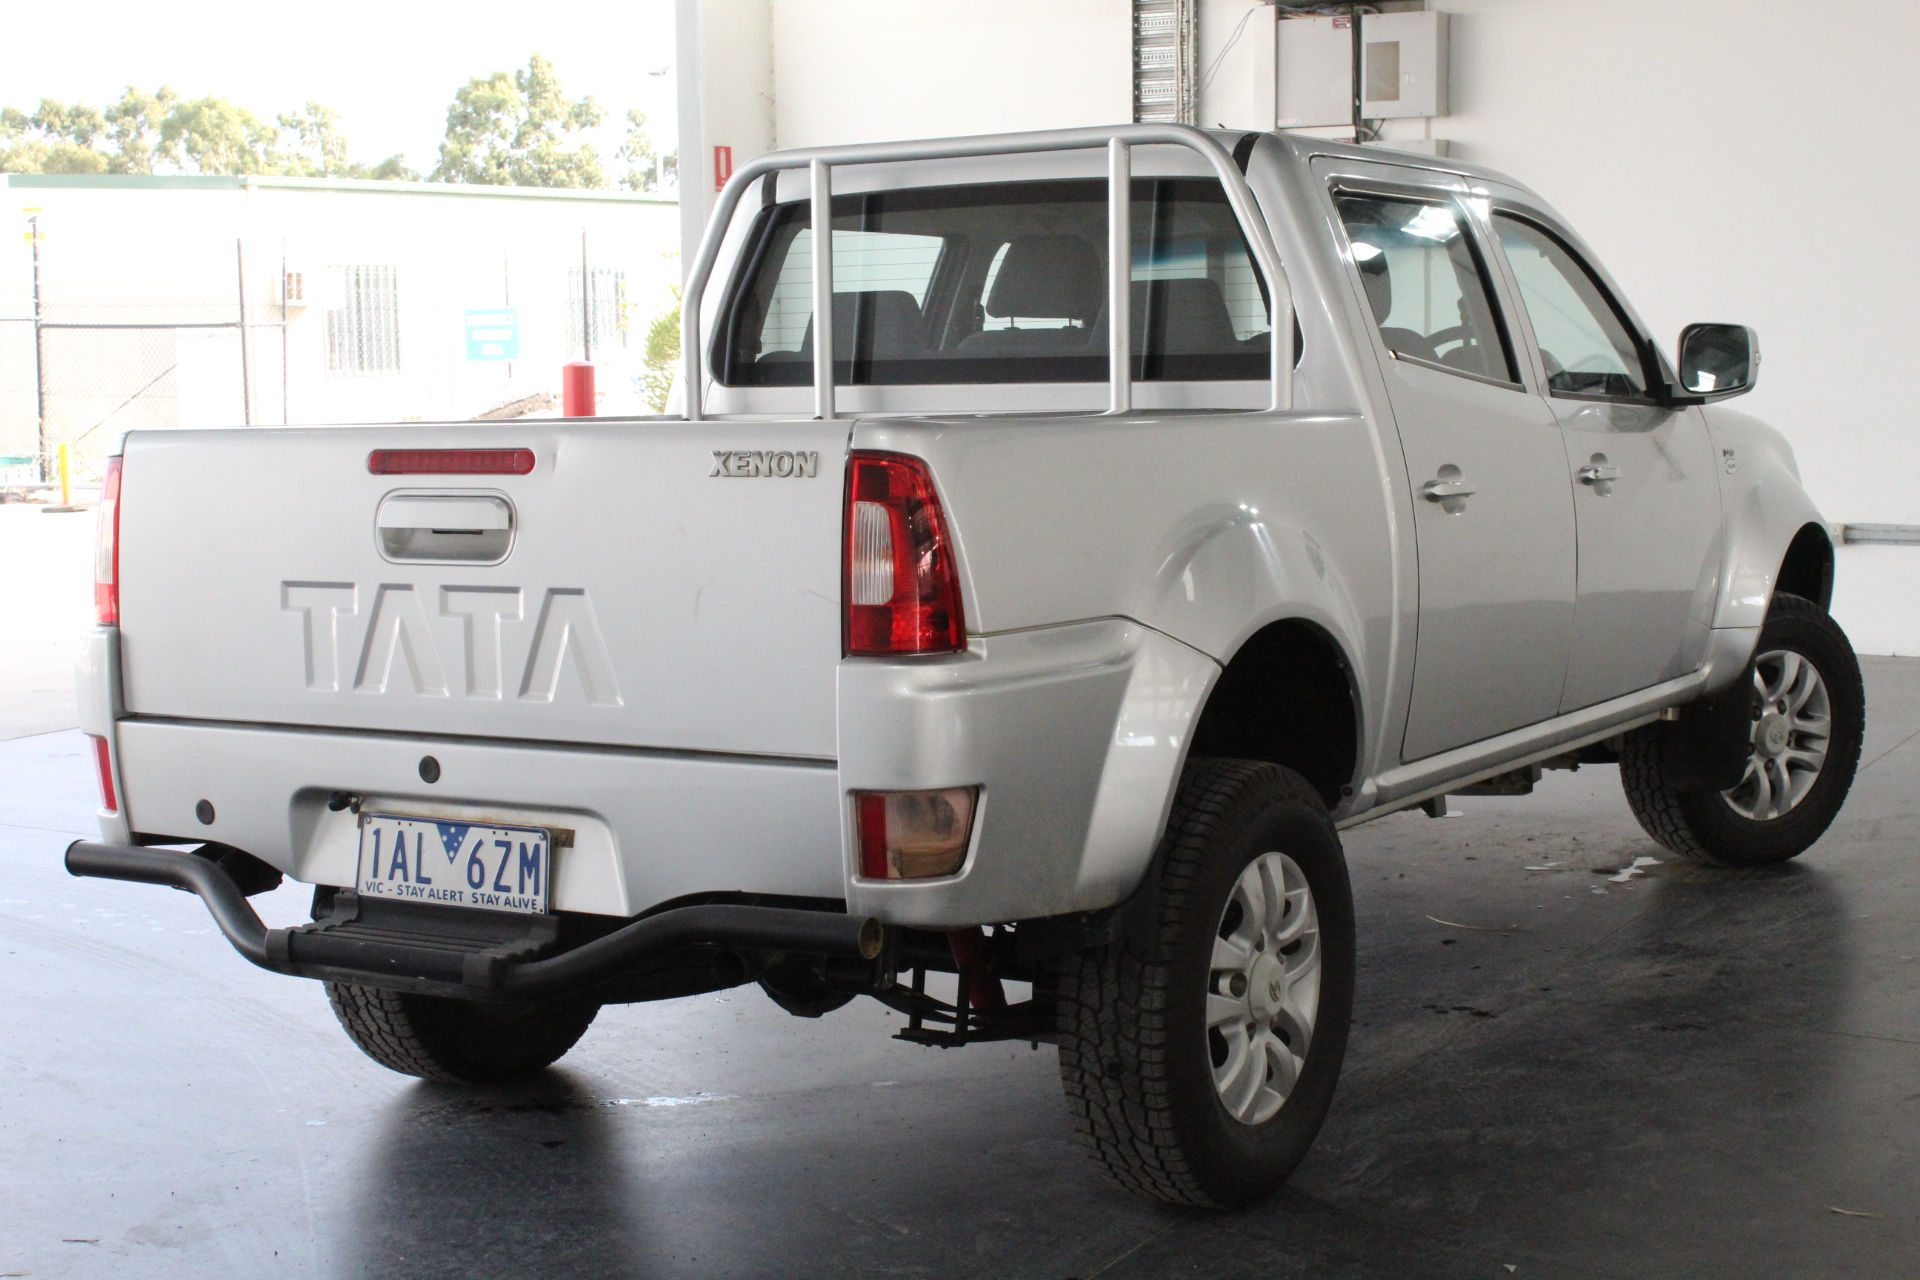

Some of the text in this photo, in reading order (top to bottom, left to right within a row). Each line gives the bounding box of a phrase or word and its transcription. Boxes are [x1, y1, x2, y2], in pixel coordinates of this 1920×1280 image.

[709, 450, 818, 478] XENON
[280, 580, 625, 707] TATA
[365, 880, 384, 894] VIC
[396, 884, 426, 898] STAY
[428, 888, 464, 902] ALERT
[471, 893, 501, 906] STAY
[504, 896, 538, 910] ALIVE
